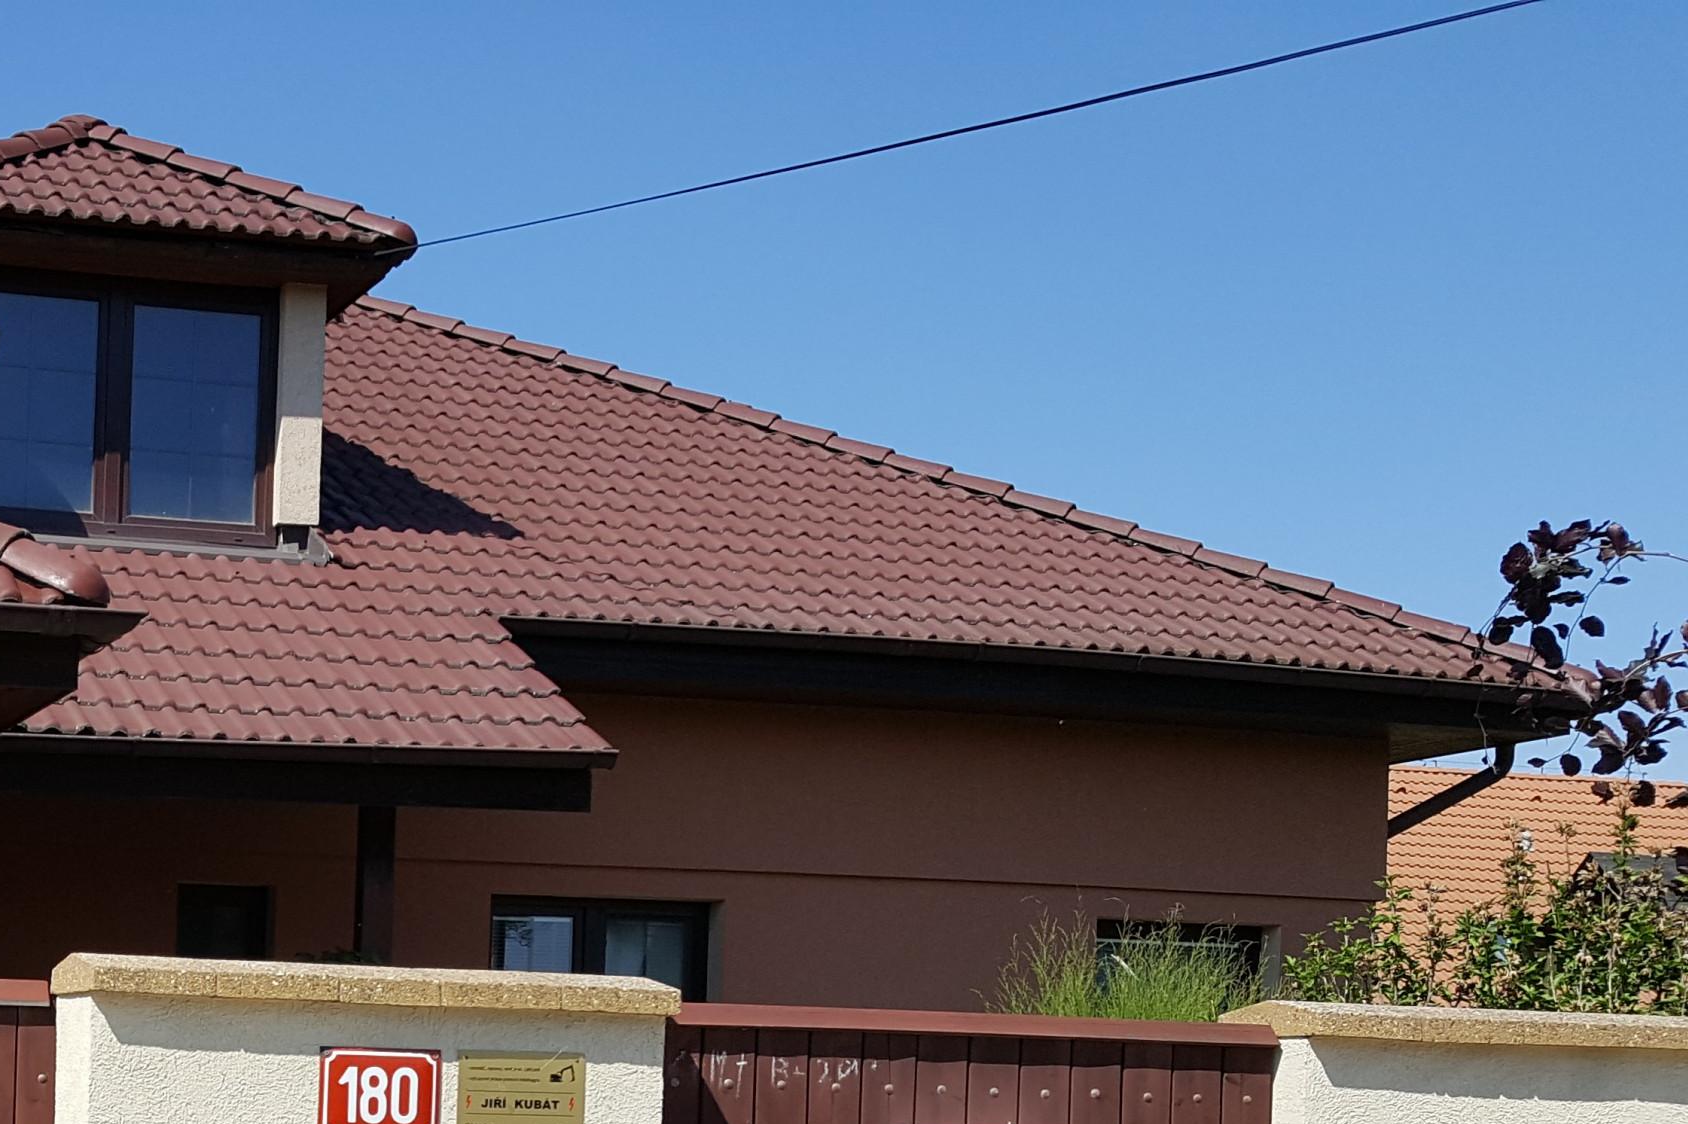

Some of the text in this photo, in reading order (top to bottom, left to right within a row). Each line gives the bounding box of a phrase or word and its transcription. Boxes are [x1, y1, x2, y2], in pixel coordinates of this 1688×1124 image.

[337, 1065, 419, 1124] 180
[480, 1096, 561, 1111] JIŘÍ KUBÁT
